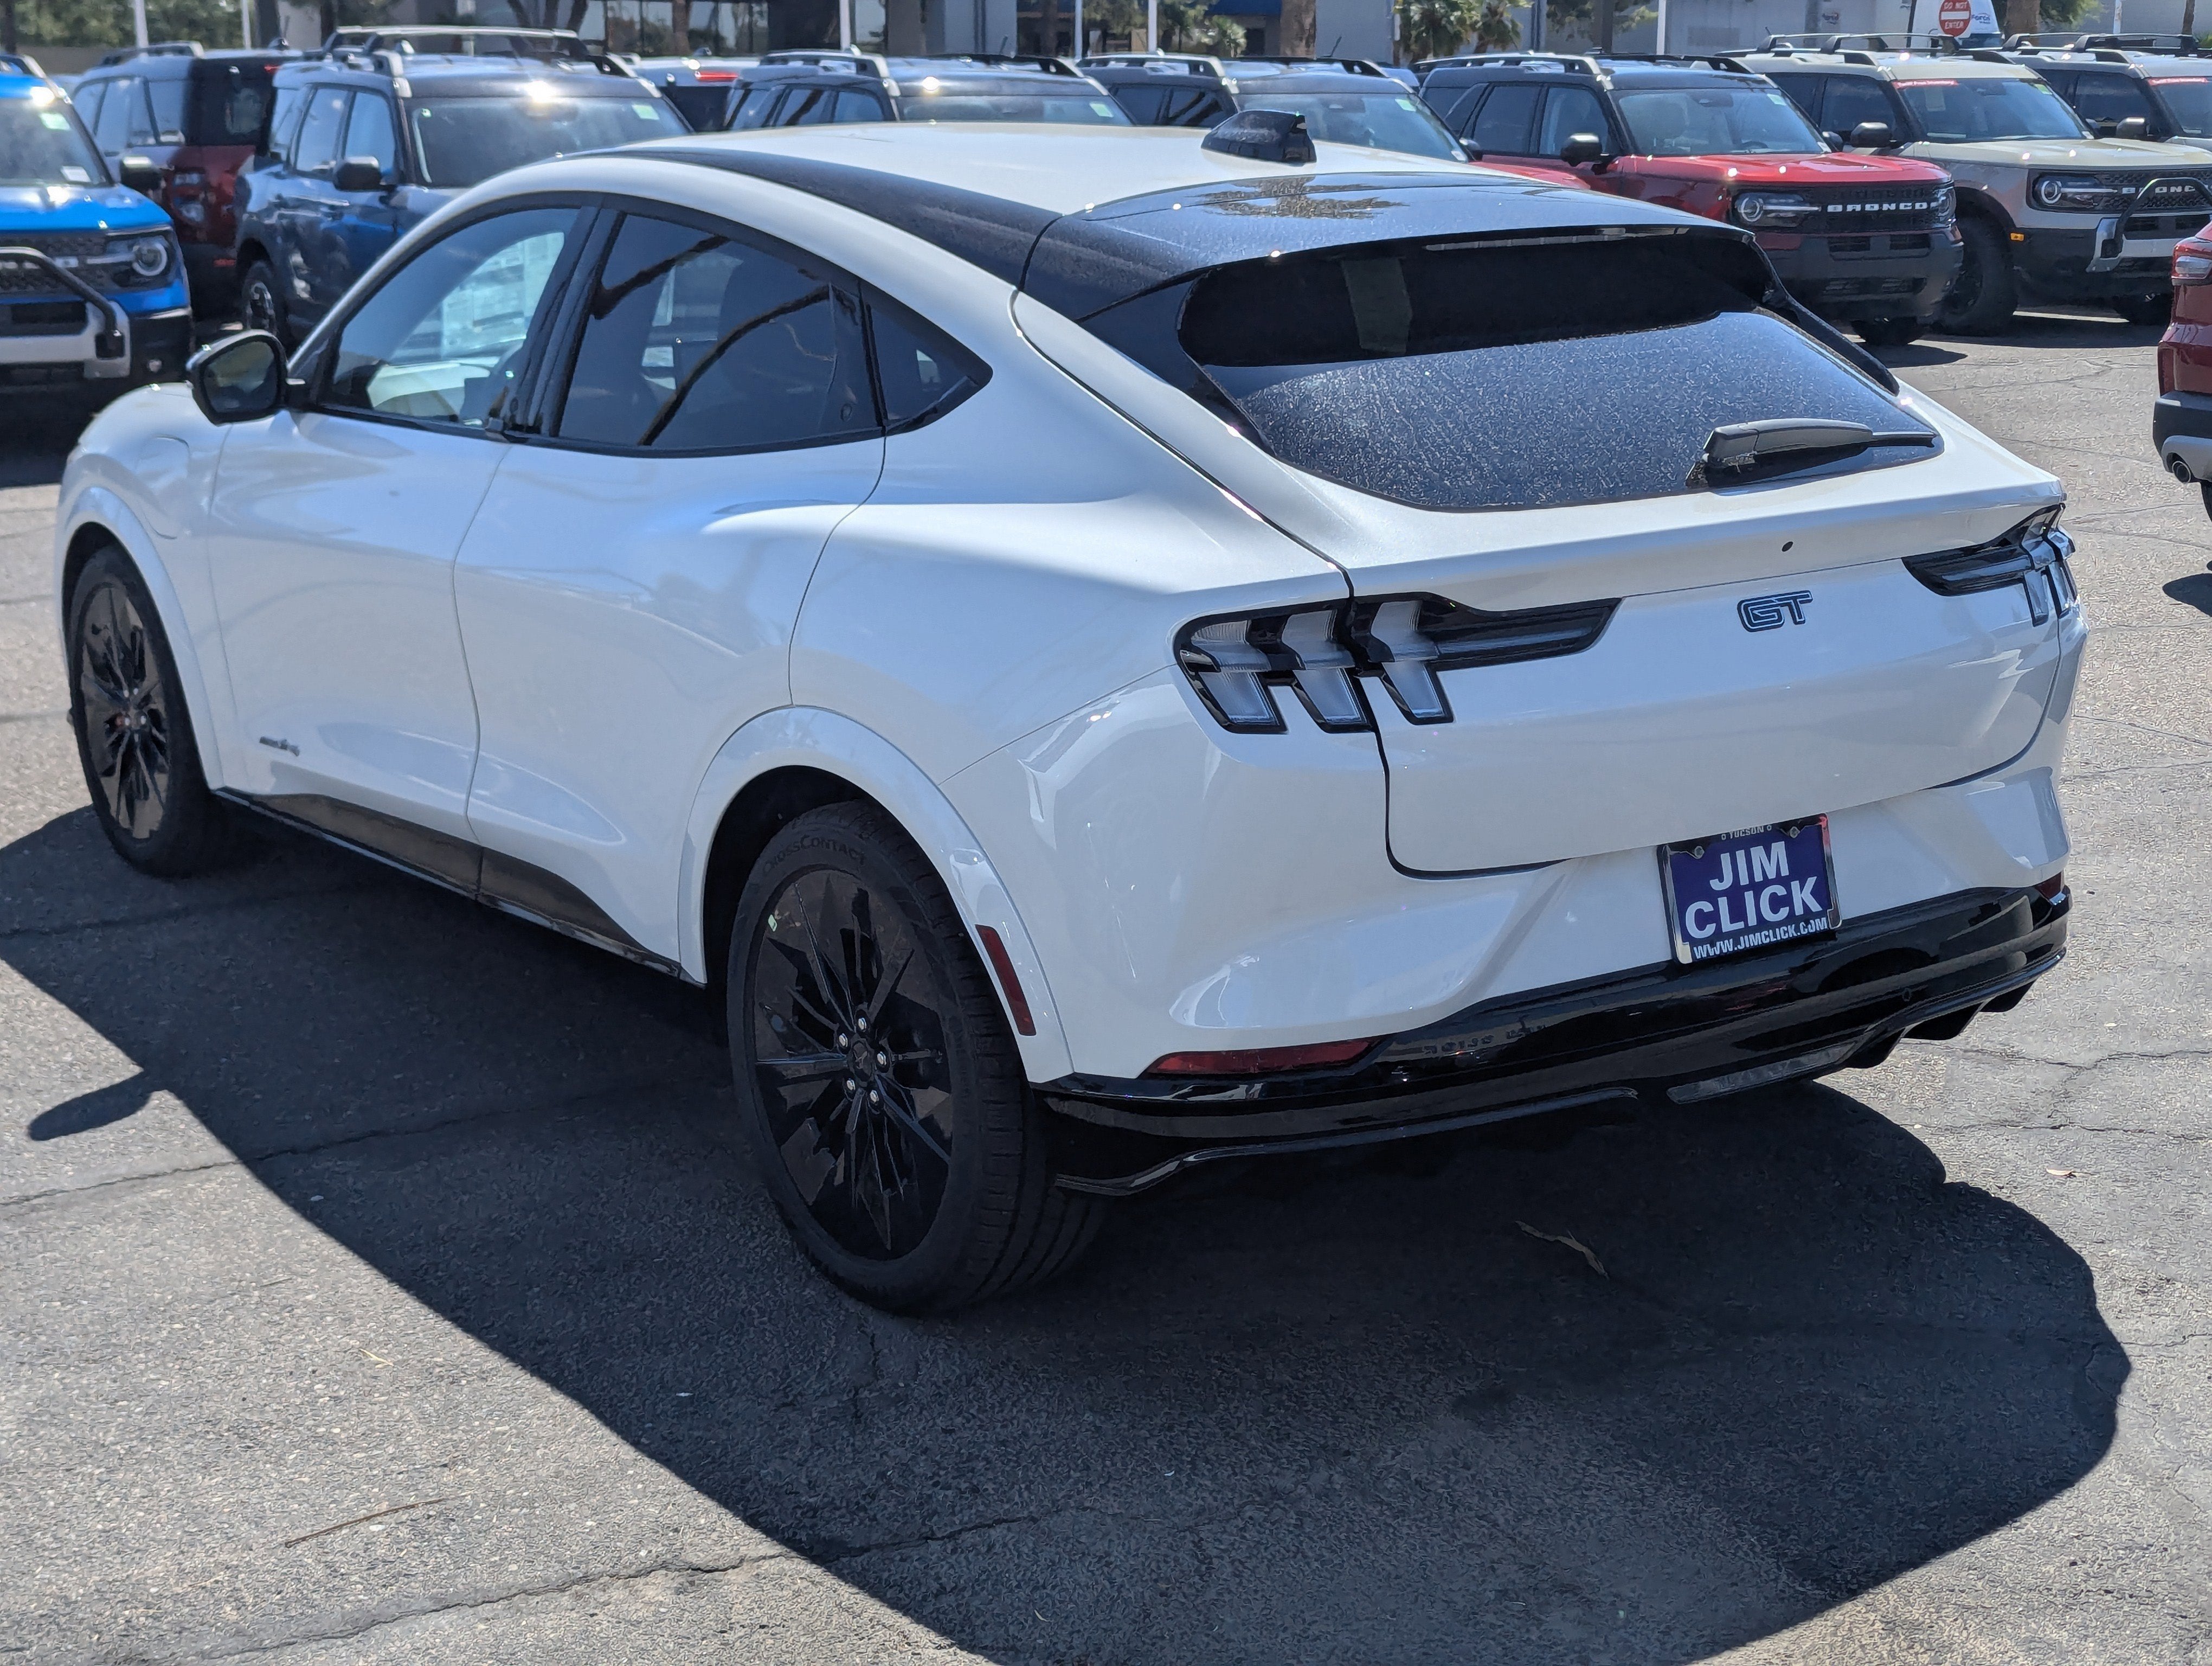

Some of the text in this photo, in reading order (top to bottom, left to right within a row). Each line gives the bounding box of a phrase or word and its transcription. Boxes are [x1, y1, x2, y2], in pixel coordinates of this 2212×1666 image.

[1945, 21, 1964, 29] ENTER
[1827, 202, 1928, 212] BRONCO
[1737, 589, 1813, 632] GT
[1729, 825, 1765, 839] TUCSON
[1709, 841, 1790, 890] JIM
[1685, 876, 1823, 939] CLICK
[1693, 917, 1828, 959] WWW.JIMCLICK.COM
